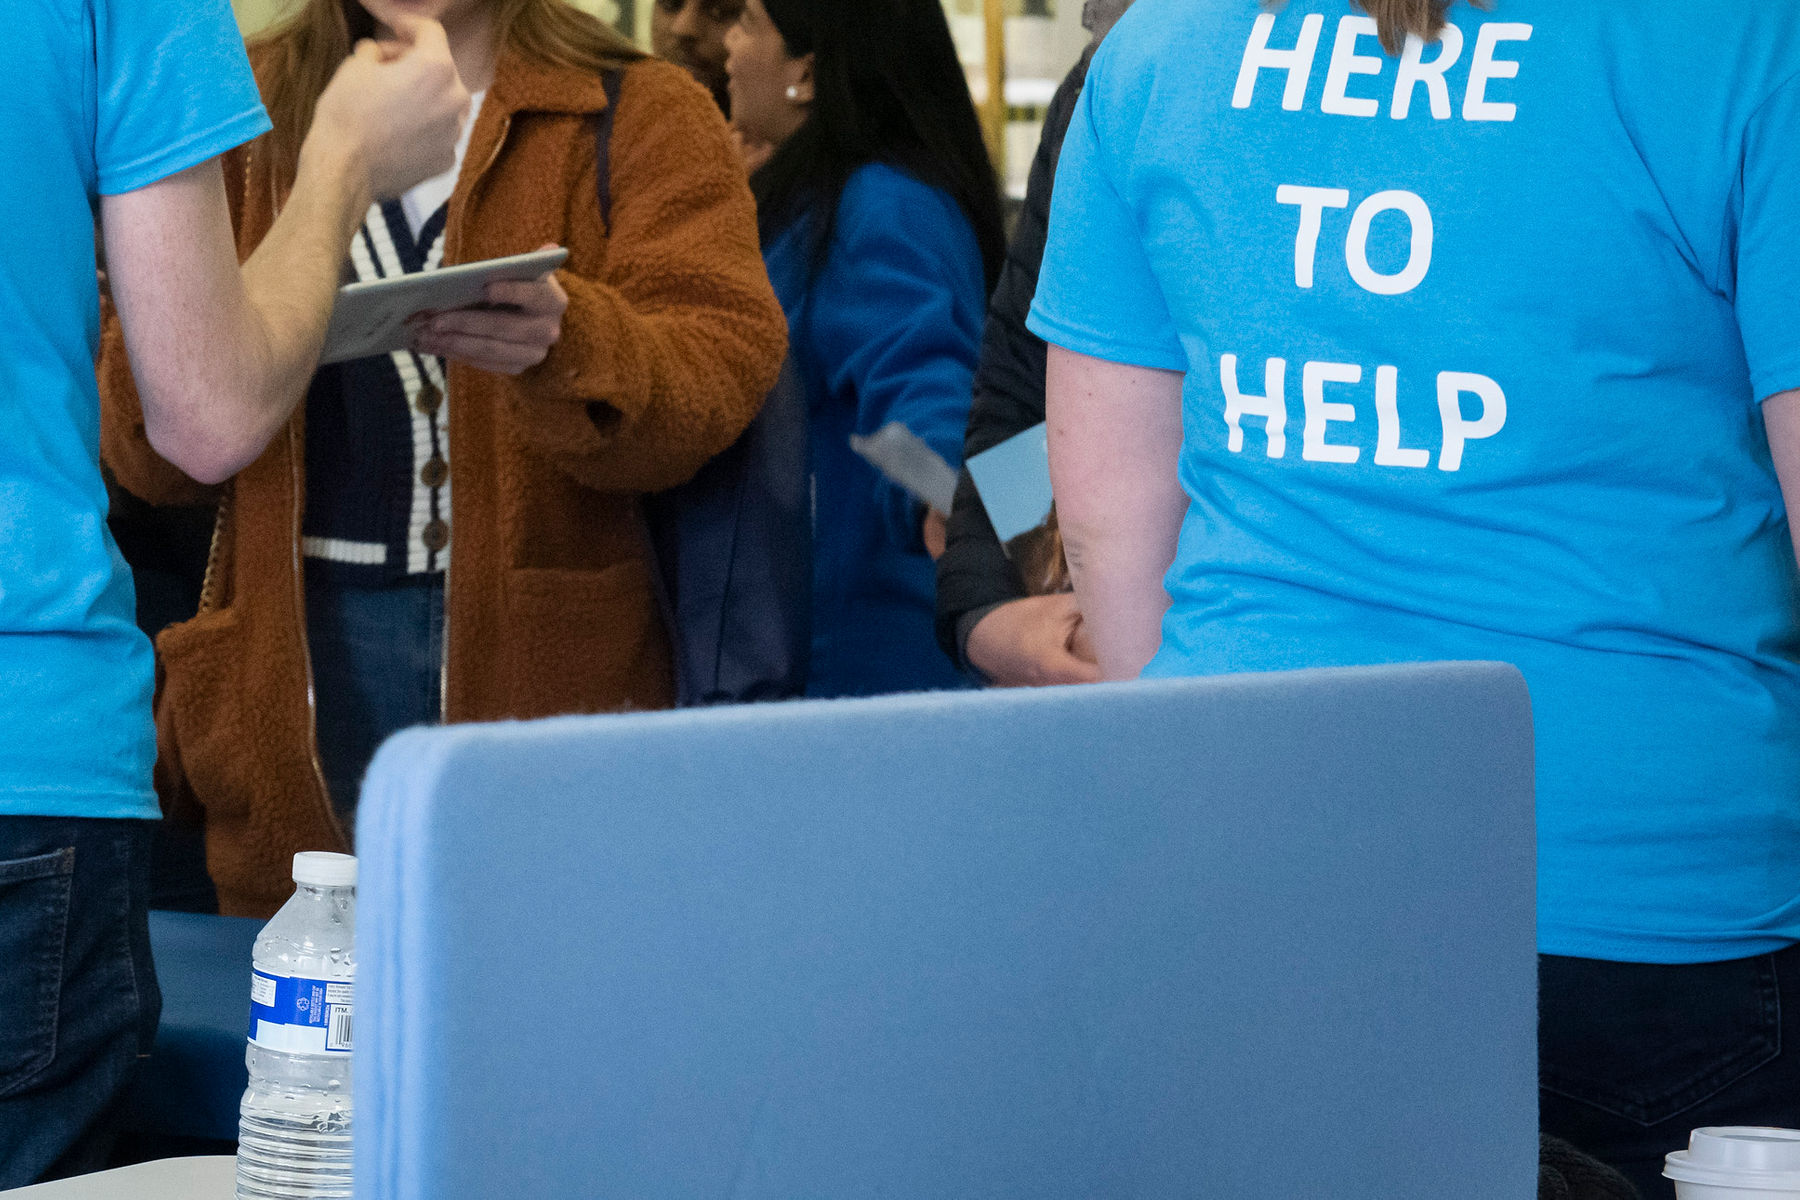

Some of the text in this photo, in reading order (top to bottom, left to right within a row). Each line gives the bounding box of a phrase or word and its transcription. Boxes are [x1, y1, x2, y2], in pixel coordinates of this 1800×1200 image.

[1230, 12, 1534, 123] HERE
[1275, 184, 1434, 296] TO
[1219, 353, 1508, 472] HELP
